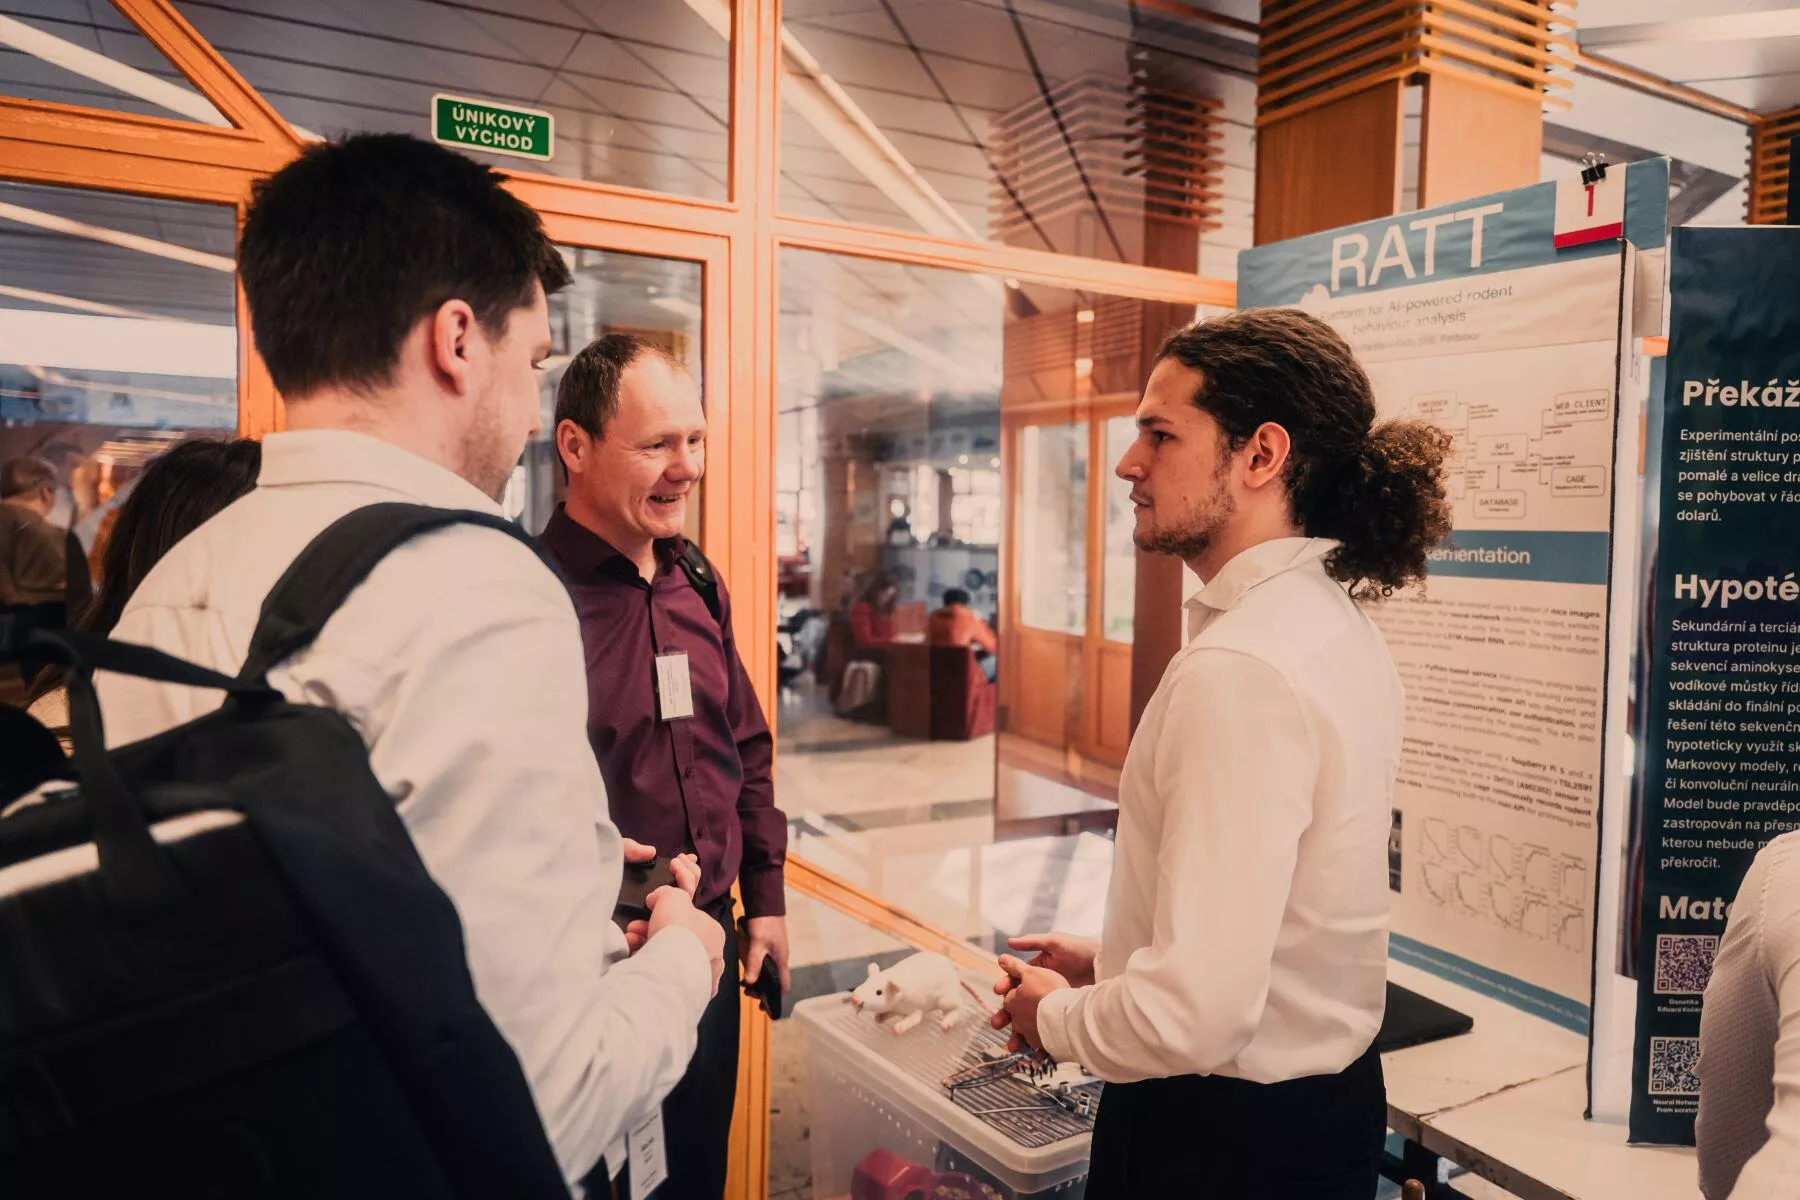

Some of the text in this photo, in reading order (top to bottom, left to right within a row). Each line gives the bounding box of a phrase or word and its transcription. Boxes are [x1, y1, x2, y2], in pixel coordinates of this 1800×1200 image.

[452, 104, 536, 133] ÚNIKOVÝ
[455, 124, 533, 151] VÝCHOD
[1584, 184, 1595, 217] 1
[1330, 202, 1504, 293] RATT
[1389, 290, 1462, 314] AI-powered
[1467, 284, 1514, 302] rodent
[1416, 309, 1467, 327] analysis
[1682, 378, 1800, 407] Překáž
[1575, 399, 1607, 409] CLIENT
[1680, 429, 1778, 444] Experimentální
[1679, 449, 1727, 463] zjištění
[1730, 450, 1789, 465] struktury
[1678, 470, 1728, 483] pomalé
[1731, 473, 1739, 482] a
[1742, 471, 1780, 482] velice
[1478, 498, 1520, 507] DATABASE
[1678, 491, 1693, 501] se
[1697, 490, 1766, 504] pohybovat
[1770, 493, 1777, 502] v
[1677, 508, 1722, 521] dolarů.
[1675, 572, 1800, 608] Hypoté
[1672, 620, 1746, 632] Sekundární
[1749, 624, 1757, 633] a
[1671, 641, 1730, 652] struktura
[1733, 641, 1787, 654] proteinu
[1670, 660, 1800, 676] sekvencí aminokyse
[1669, 679, 1727, 691] vodíkové
[1730, 680, 1778, 695] můstky
[1668, 699, 1722, 711] skládání
[1724, 701, 1741, 711] do
[1746, 700, 1785, 712] finální
[1667, 718, 1800, 733] řešení této sekvenčn
[1666, 739, 1742, 754] hypoteticky
[1746, 740, 1784, 754] využít
[1666, 758, 1736, 773] Markovovy
[1740, 760, 1789, 774] modely,
[1665, 777, 1800, 792] či konvoluční neuráln
[1664, 797, 1703, 809] Model
[1707, 798, 1740, 810] bude
[1663, 817, 1742, 830] zastropován
[1745, 821, 1760, 830] na
[1662, 837, 1703, 848] kterou
[1706, 838, 1754, 849] nebude
[1661, 855, 1721, 870] překročit.
[1659, 895, 1733, 920] Mat
